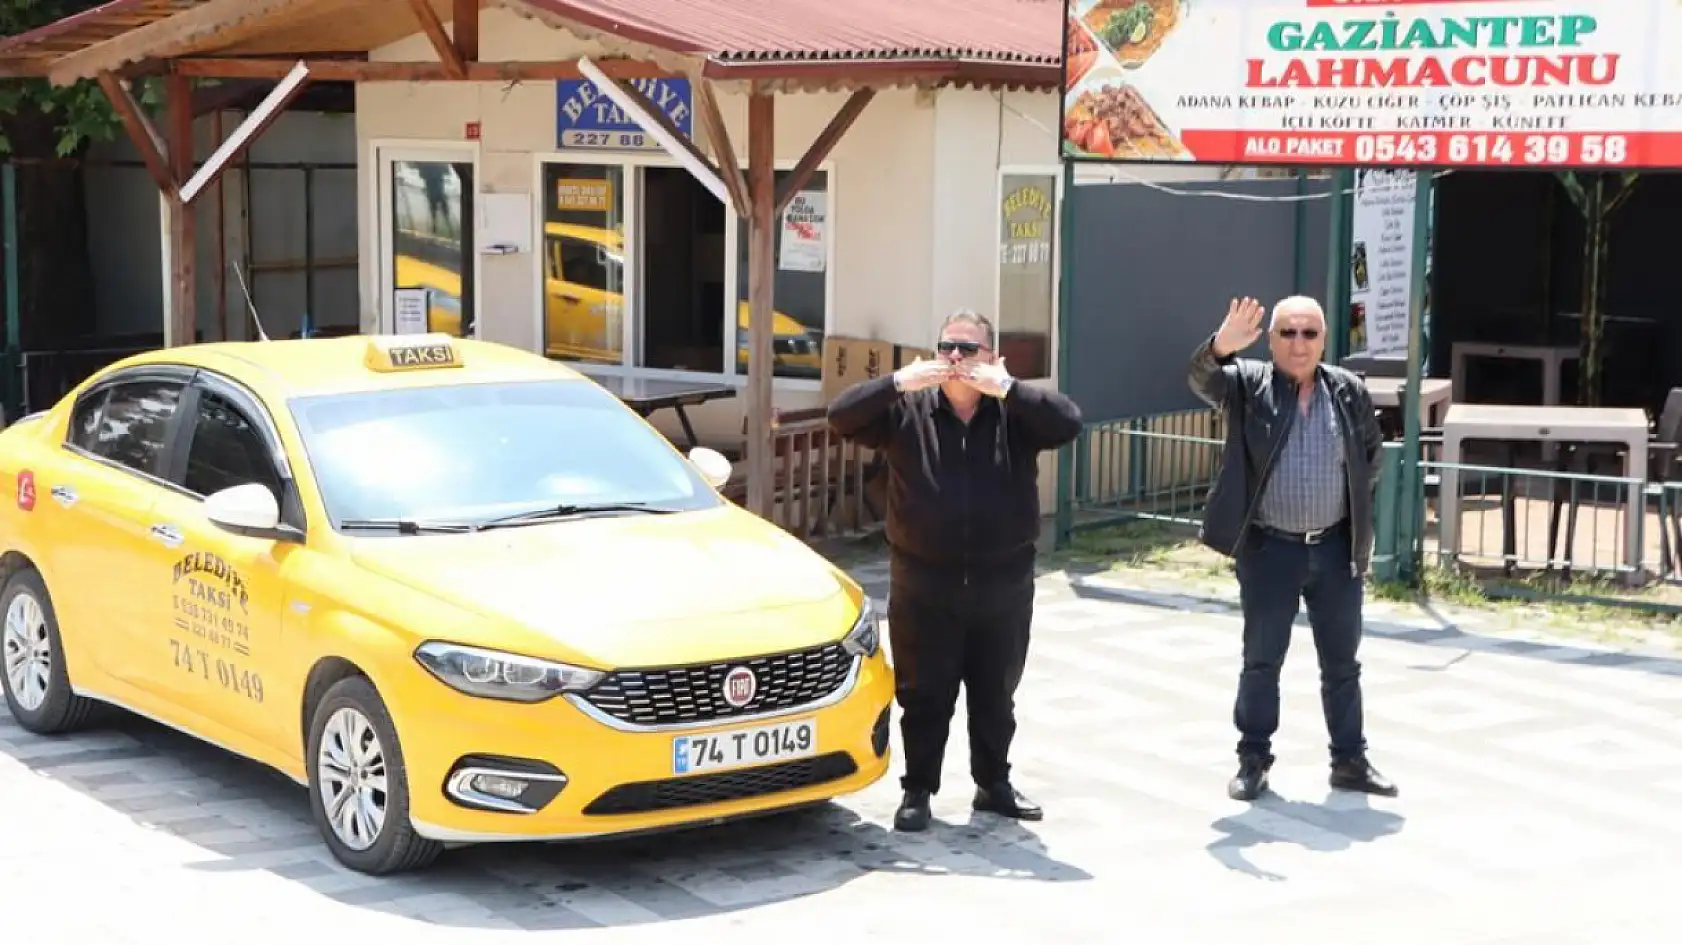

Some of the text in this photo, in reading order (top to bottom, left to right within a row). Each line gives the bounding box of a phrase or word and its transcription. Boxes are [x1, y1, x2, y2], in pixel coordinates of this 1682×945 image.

[1266, 11, 1597, 50] GAZİANTEP
[1245, 53, 1620, 88] LAHMACUNU
[1176, 95, 1231, 109] ADANA
[1239, 95, 1295, 108] KEBAP
[1313, 95, 1360, 109] KUZU
[1439, 92, 1475, 111] ÇÖP
[1533, 93, 1625, 108] PATLICAN
[1320, 113, 1375, 129] KÖFTE
[1397, 115, 1471, 129] KATMER
[1492, 113, 1567, 129] KÜNEFE
[573, 133, 610, 146] 227
[619, 134, 645, 147] 88
[1246, 134, 1627, 162] ALO PAKET 0543 614 39 58
[391, 343, 453, 364] TAKSİ
[172, 551, 249, 615] BELEDİYE
[189, 578, 231, 610] TAKSİ
[170, 638, 264, 703] 74 T 0149
[692, 737, 723, 767] 74
[732, 733, 748, 760] T
[754, 725, 811, 757] 0149
